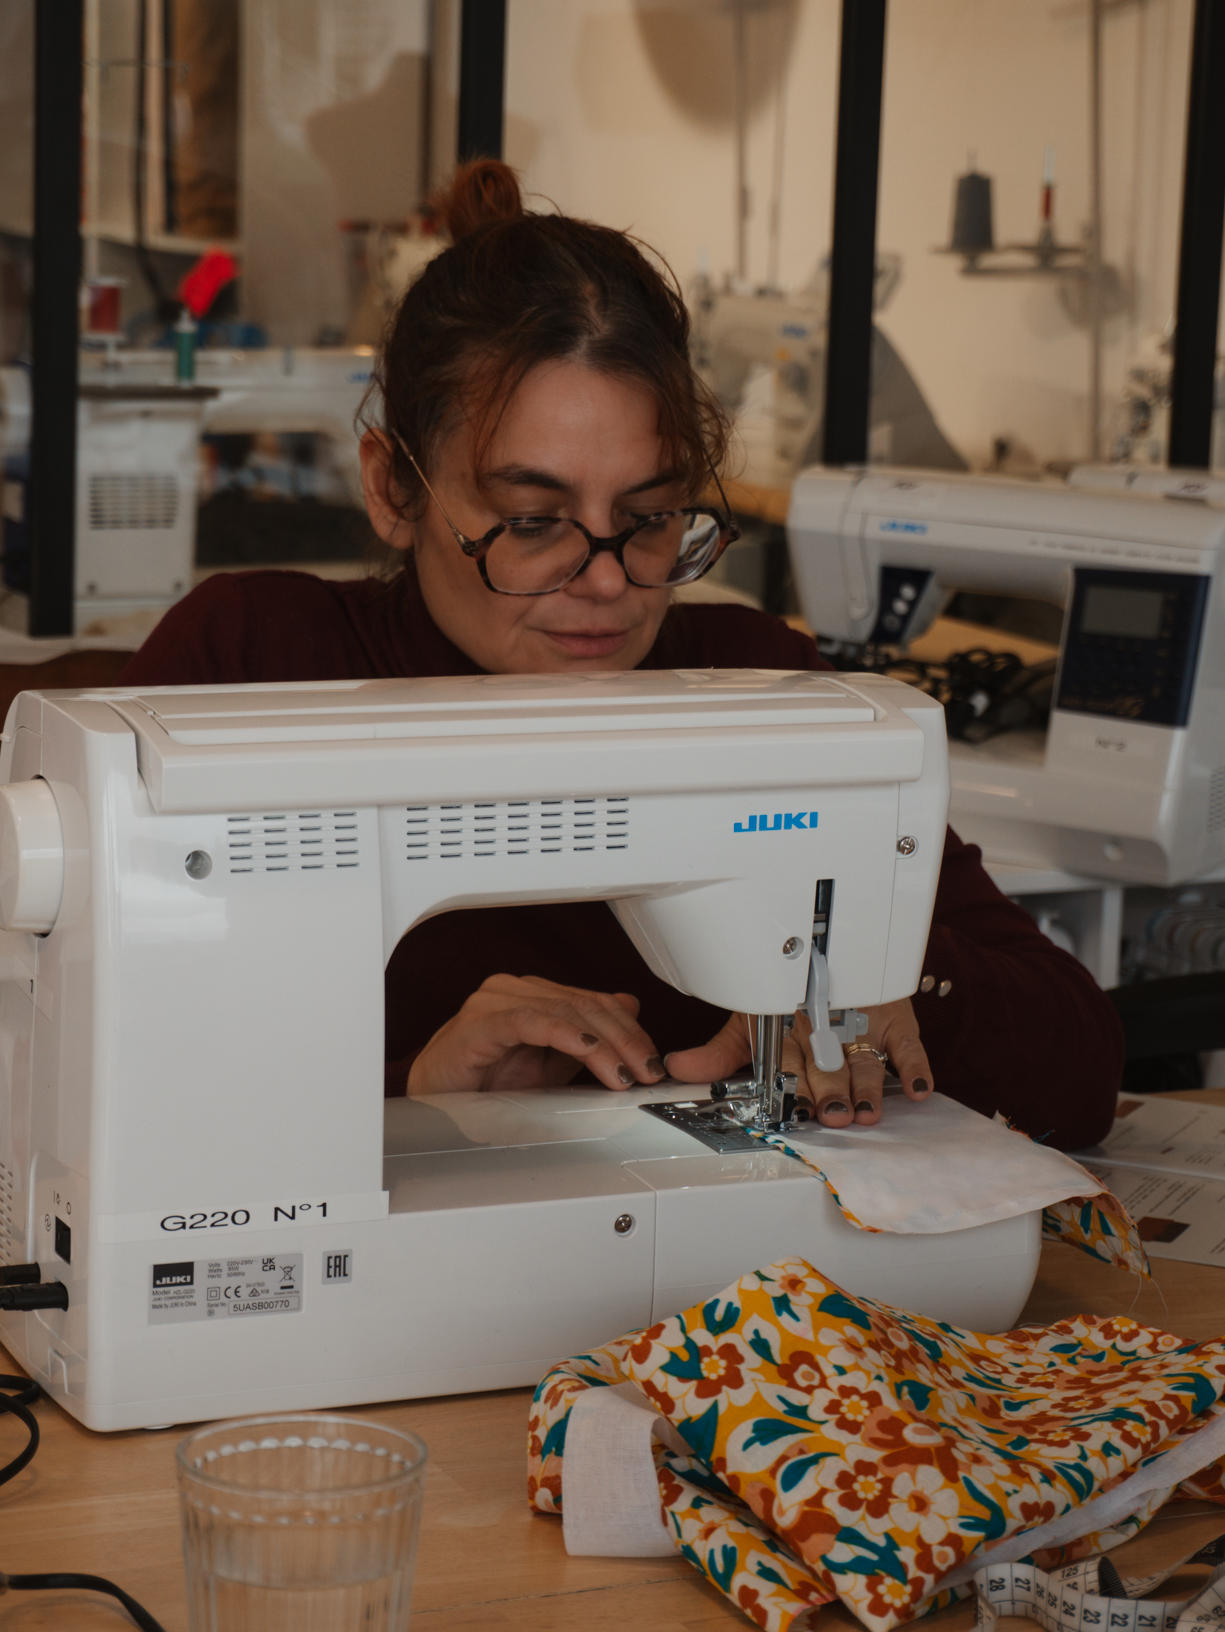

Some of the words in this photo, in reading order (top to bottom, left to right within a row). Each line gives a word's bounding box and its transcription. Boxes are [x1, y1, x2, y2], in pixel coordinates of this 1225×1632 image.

[733, 811, 819, 833] JUKI
[160, 1209, 250, 1232] G220
[273, 1202, 328, 1222] N°1
[262, 1257, 275, 1265] UK
[262, 1264, 275, 1272] CA
[326, 1254, 349, 1279] EAC
[155, 1275, 191, 1285] JUKI
[233, 1300, 290, 1312] 5UASB00770
[1061, 1565, 1079, 1579] 125
[989, 1577, 1006, 1592] 28
[1014, 1577, 1031, 1592] 27
[1036, 1582, 1045, 1599] 26
[1047, 1592, 1058, 1609] 25
[1062, 1601, 1076, 1618] 24
[1083, 1608, 1101, 1625] 23
[1110, 1613, 1129, 1628] 22
[1138, 1614, 1157, 1628] 21
